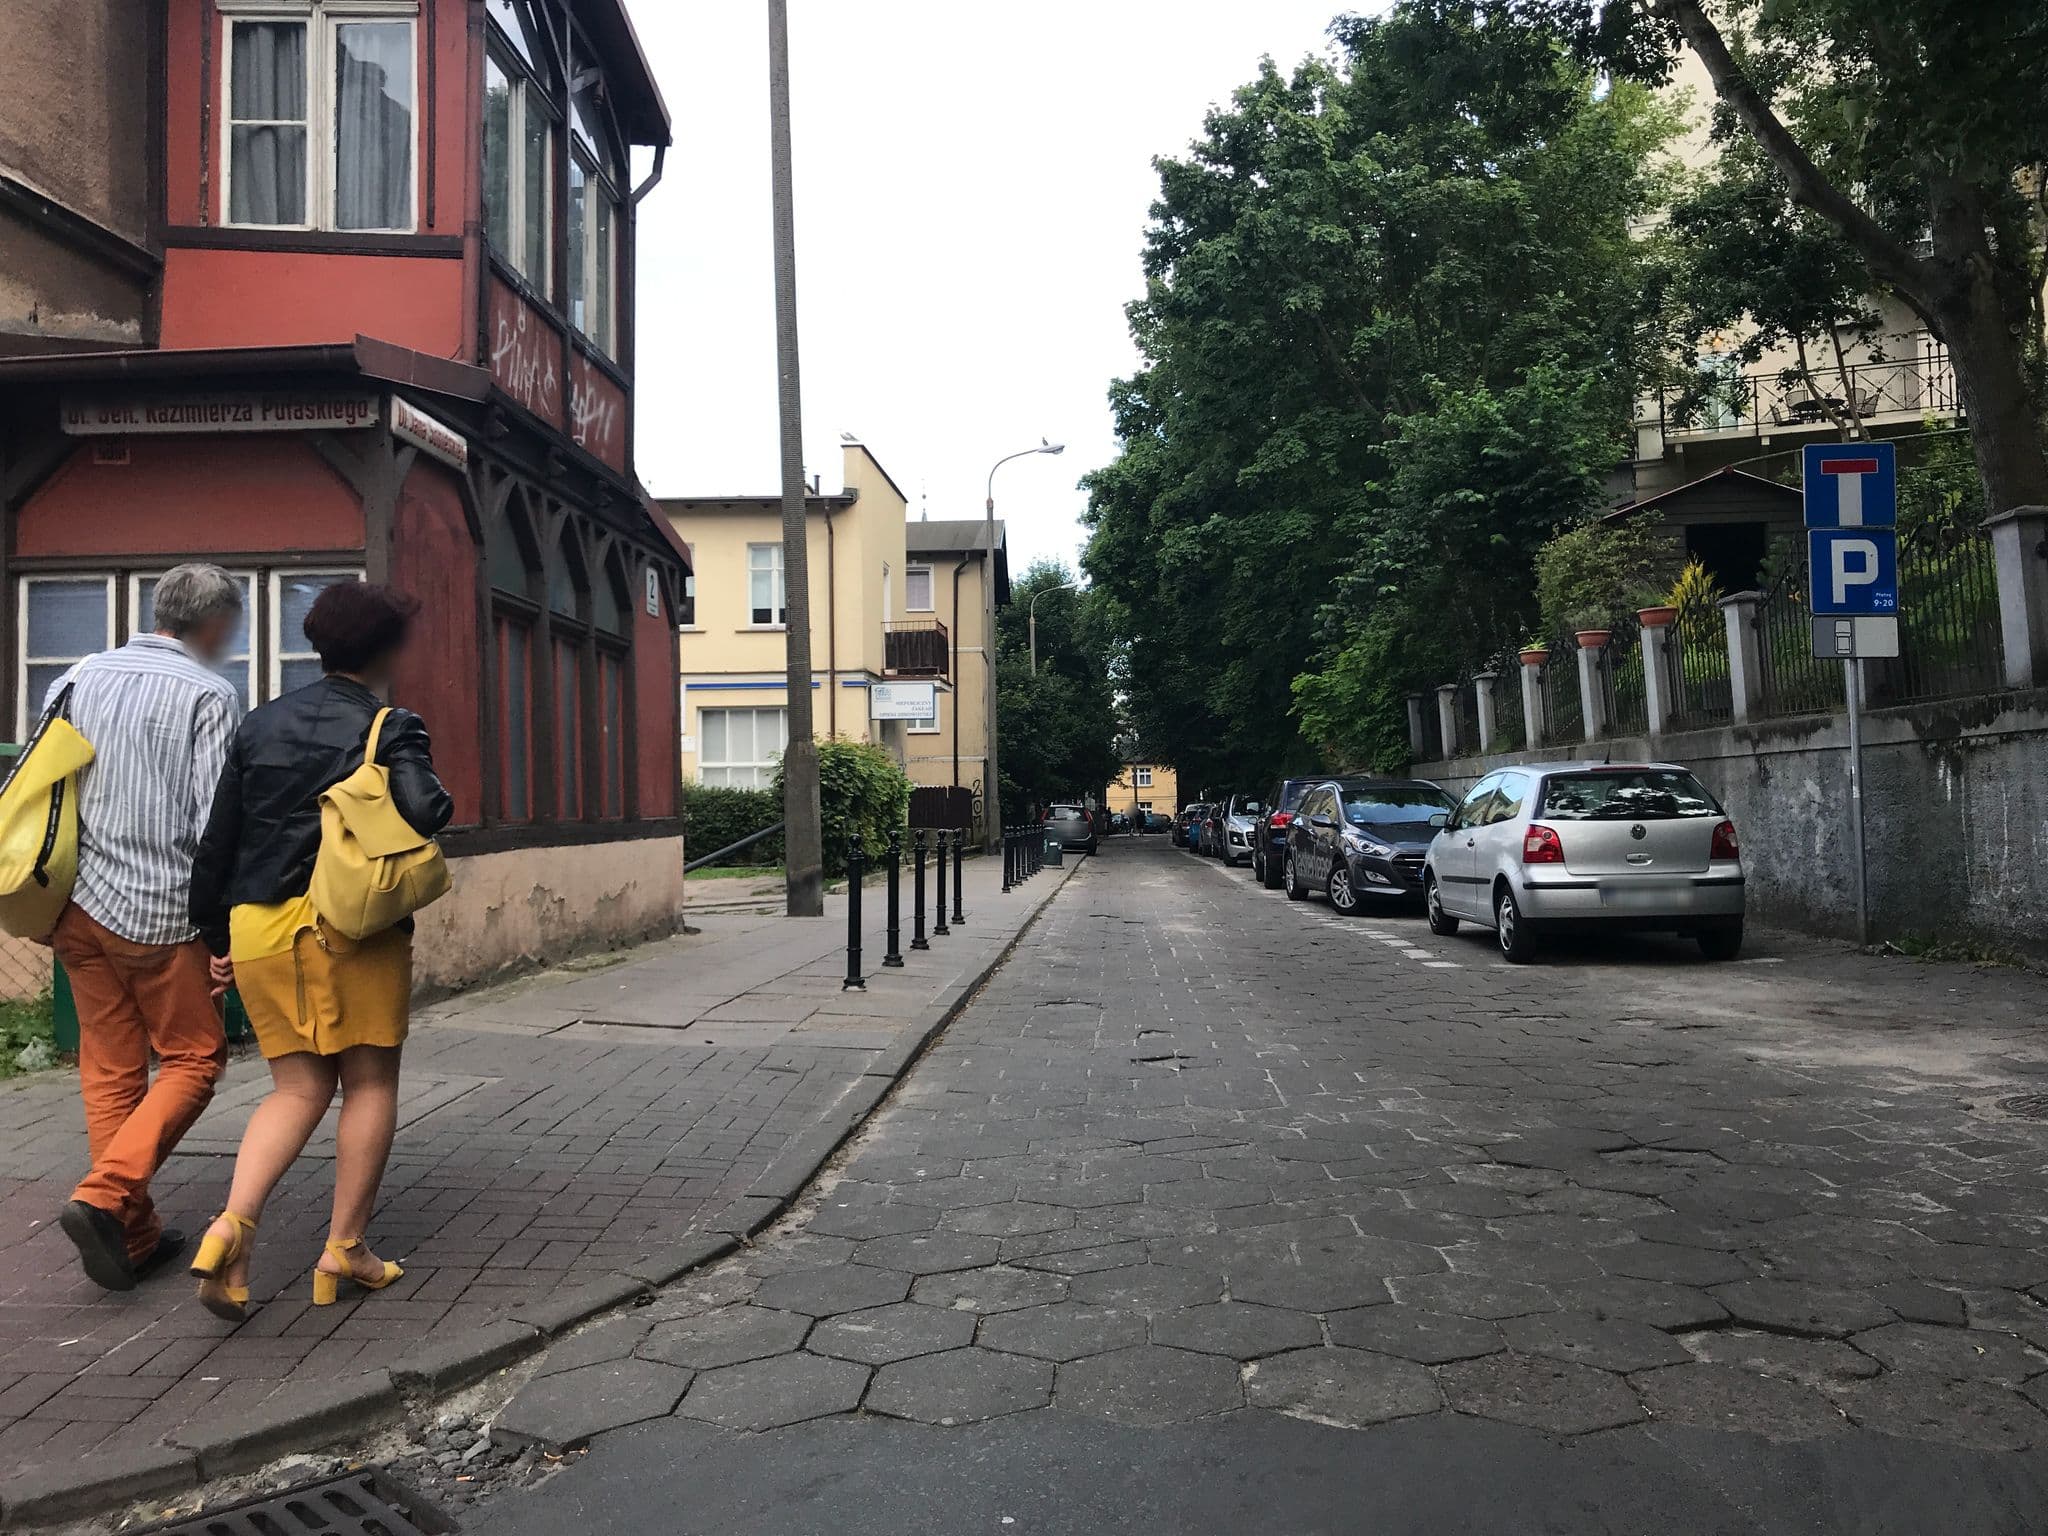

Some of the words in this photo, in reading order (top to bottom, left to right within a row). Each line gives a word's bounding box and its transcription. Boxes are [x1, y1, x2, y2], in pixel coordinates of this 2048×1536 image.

[145, 400, 253, 423] Kazimierza
[261, 396, 370, 425] Pułaskiego
[1831, 539, 1879, 604] P
[650, 574, 655, 600] 2
